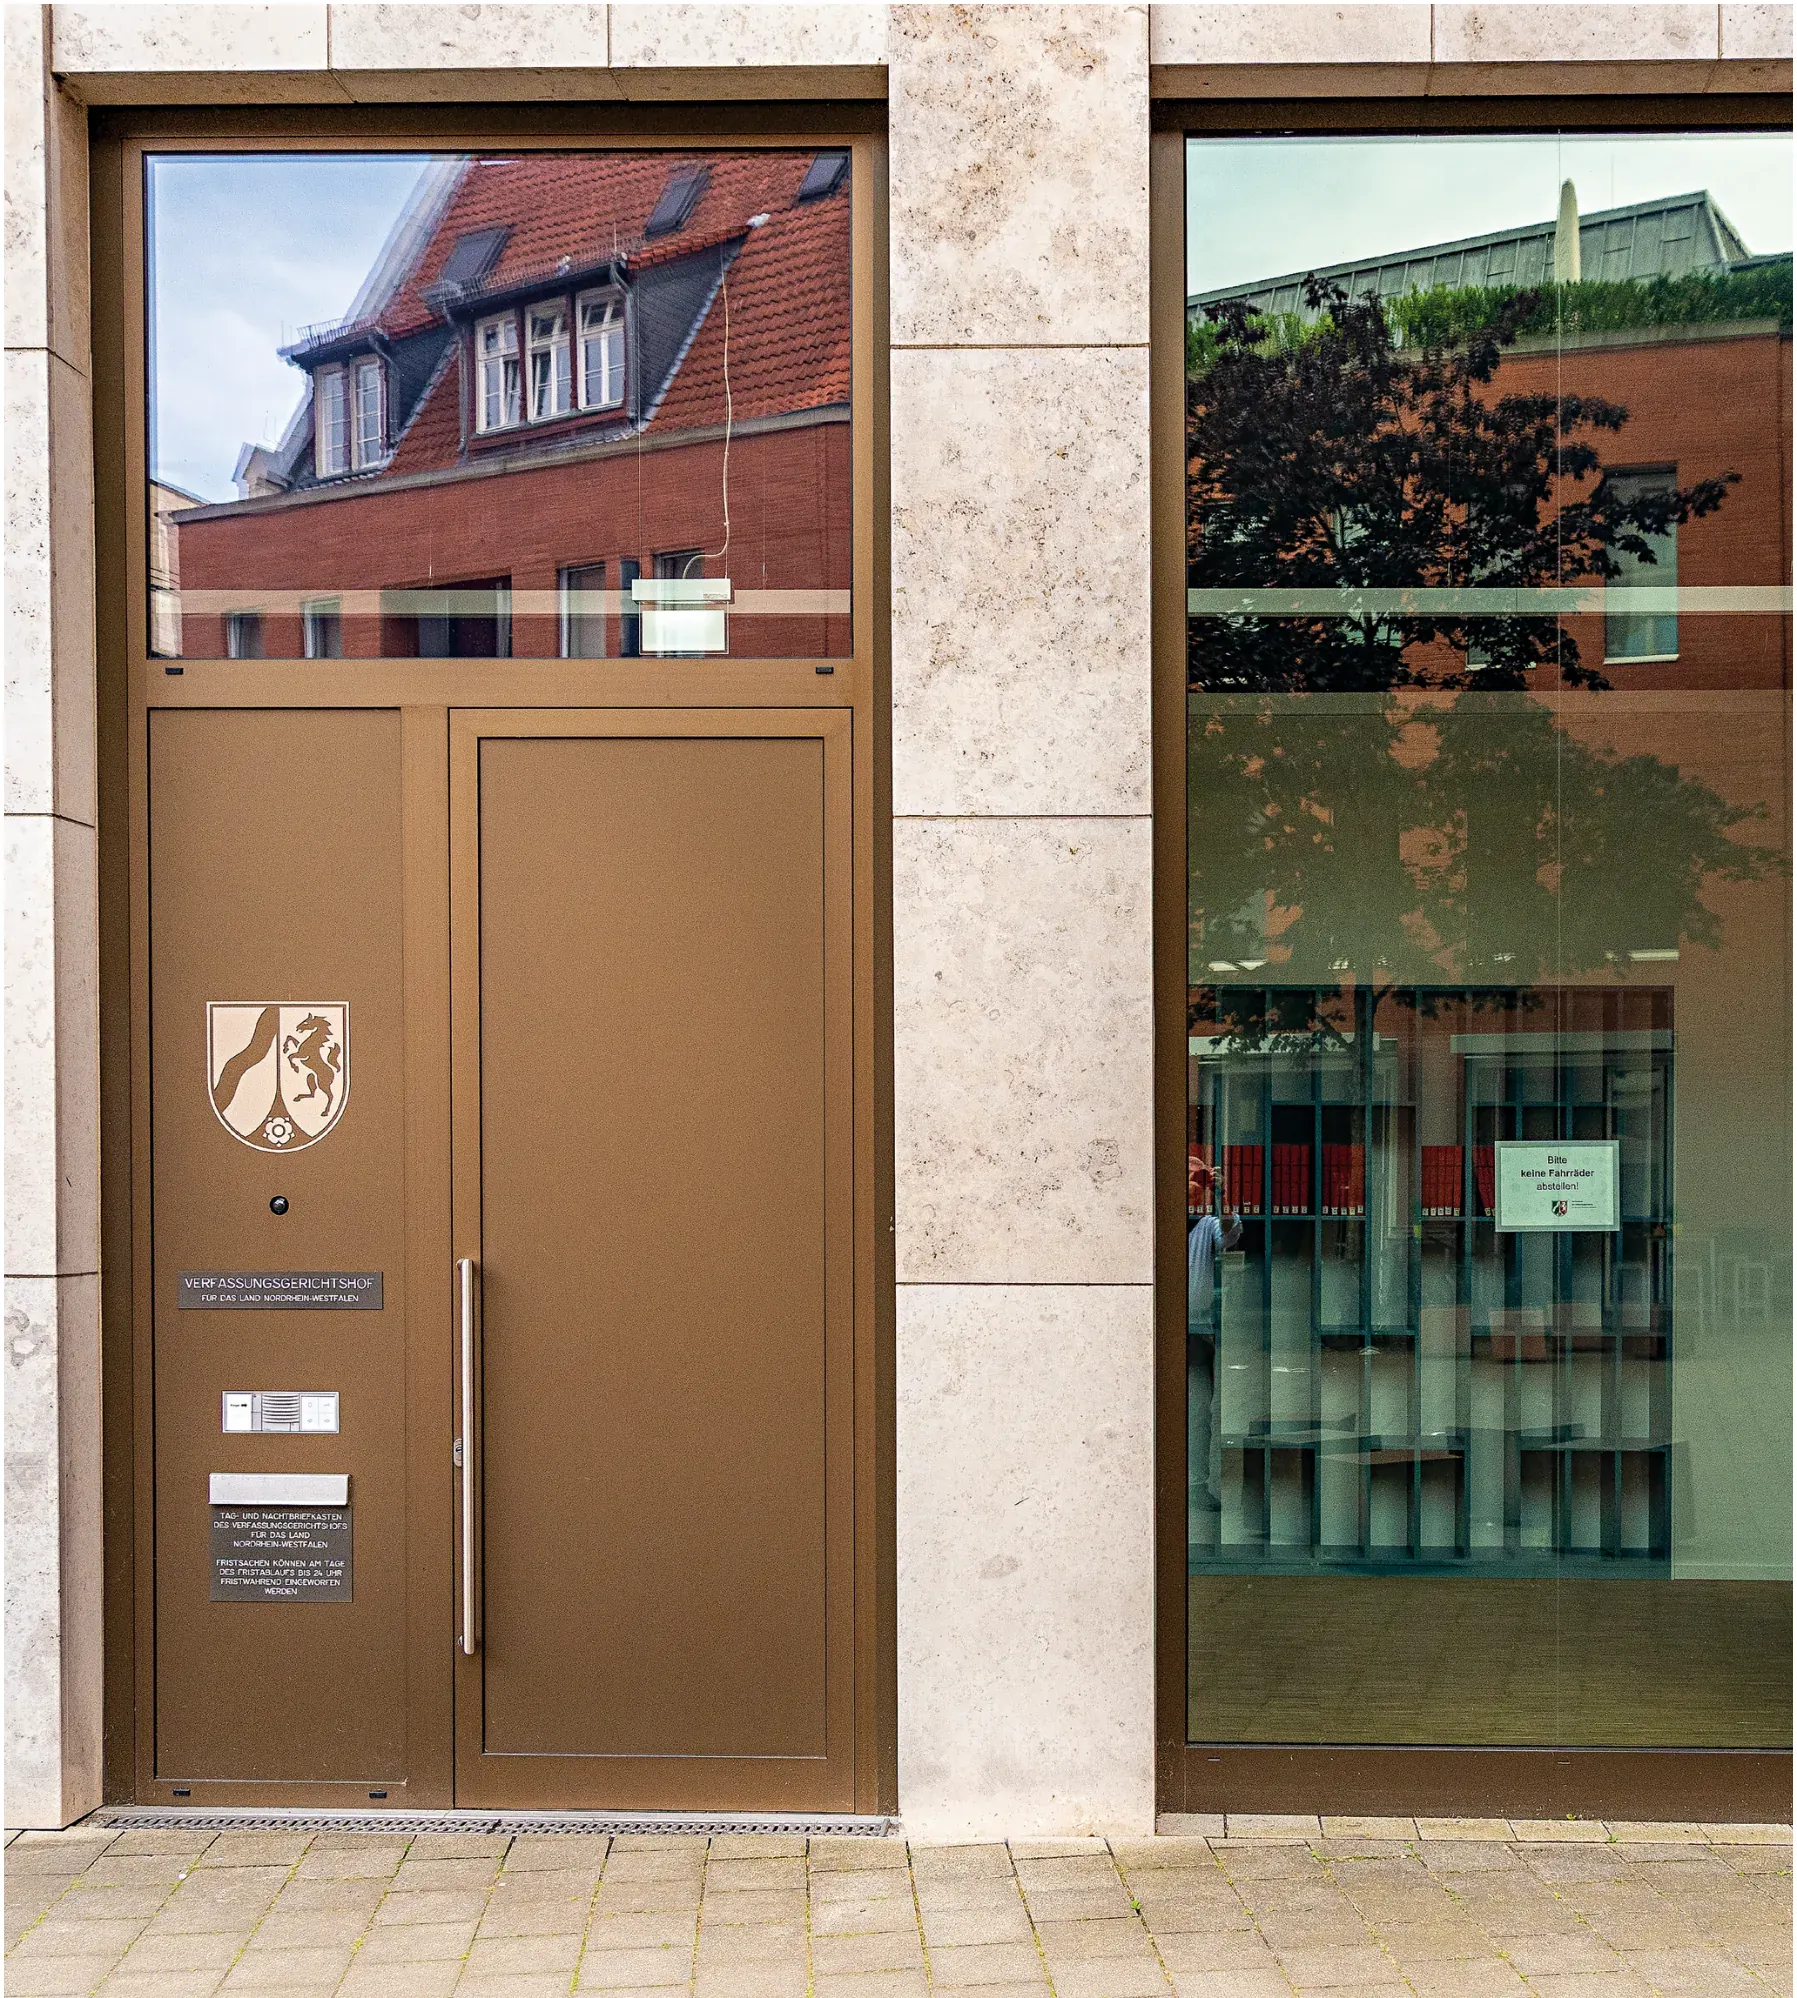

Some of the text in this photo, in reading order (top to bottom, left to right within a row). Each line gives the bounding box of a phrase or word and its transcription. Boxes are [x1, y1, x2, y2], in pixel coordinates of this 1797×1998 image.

[1547, 1156, 1567, 1164] Bitte
[1521, 1169, 1595, 1177] keine Fahrräder
[1536, 1182, 1579, 1191] abstellen!
[184, 1277, 375, 1289] VERFASSUNGSGERICHTSHOF
[201, 1293, 359, 1303] FÜR DAS LAND NORDRHEIN-WESTFALEN
[220, 1512, 343, 1521] TAG- UND NACHTBRIEFKASTEN
[213, 1521, 348, 1530] DES VERFASSUNGSGERICHTSHOFS
[251, 1530, 311, 1539] FÜR DAS LAND
[233, 1540, 328, 1549] NORDRHEIN-WESTFALEN
[216, 1559, 270, 1567] FRISTSACHEN
[272, 1558, 306, 1567] KÖNNEN
[219, 1568, 343, 1577] DES FRISTABLAUFS BIS 24 UHR
[285, 1578, 341, 1586] EINGEWORFEN
[264, 1587, 298, 1596] WERDEN
